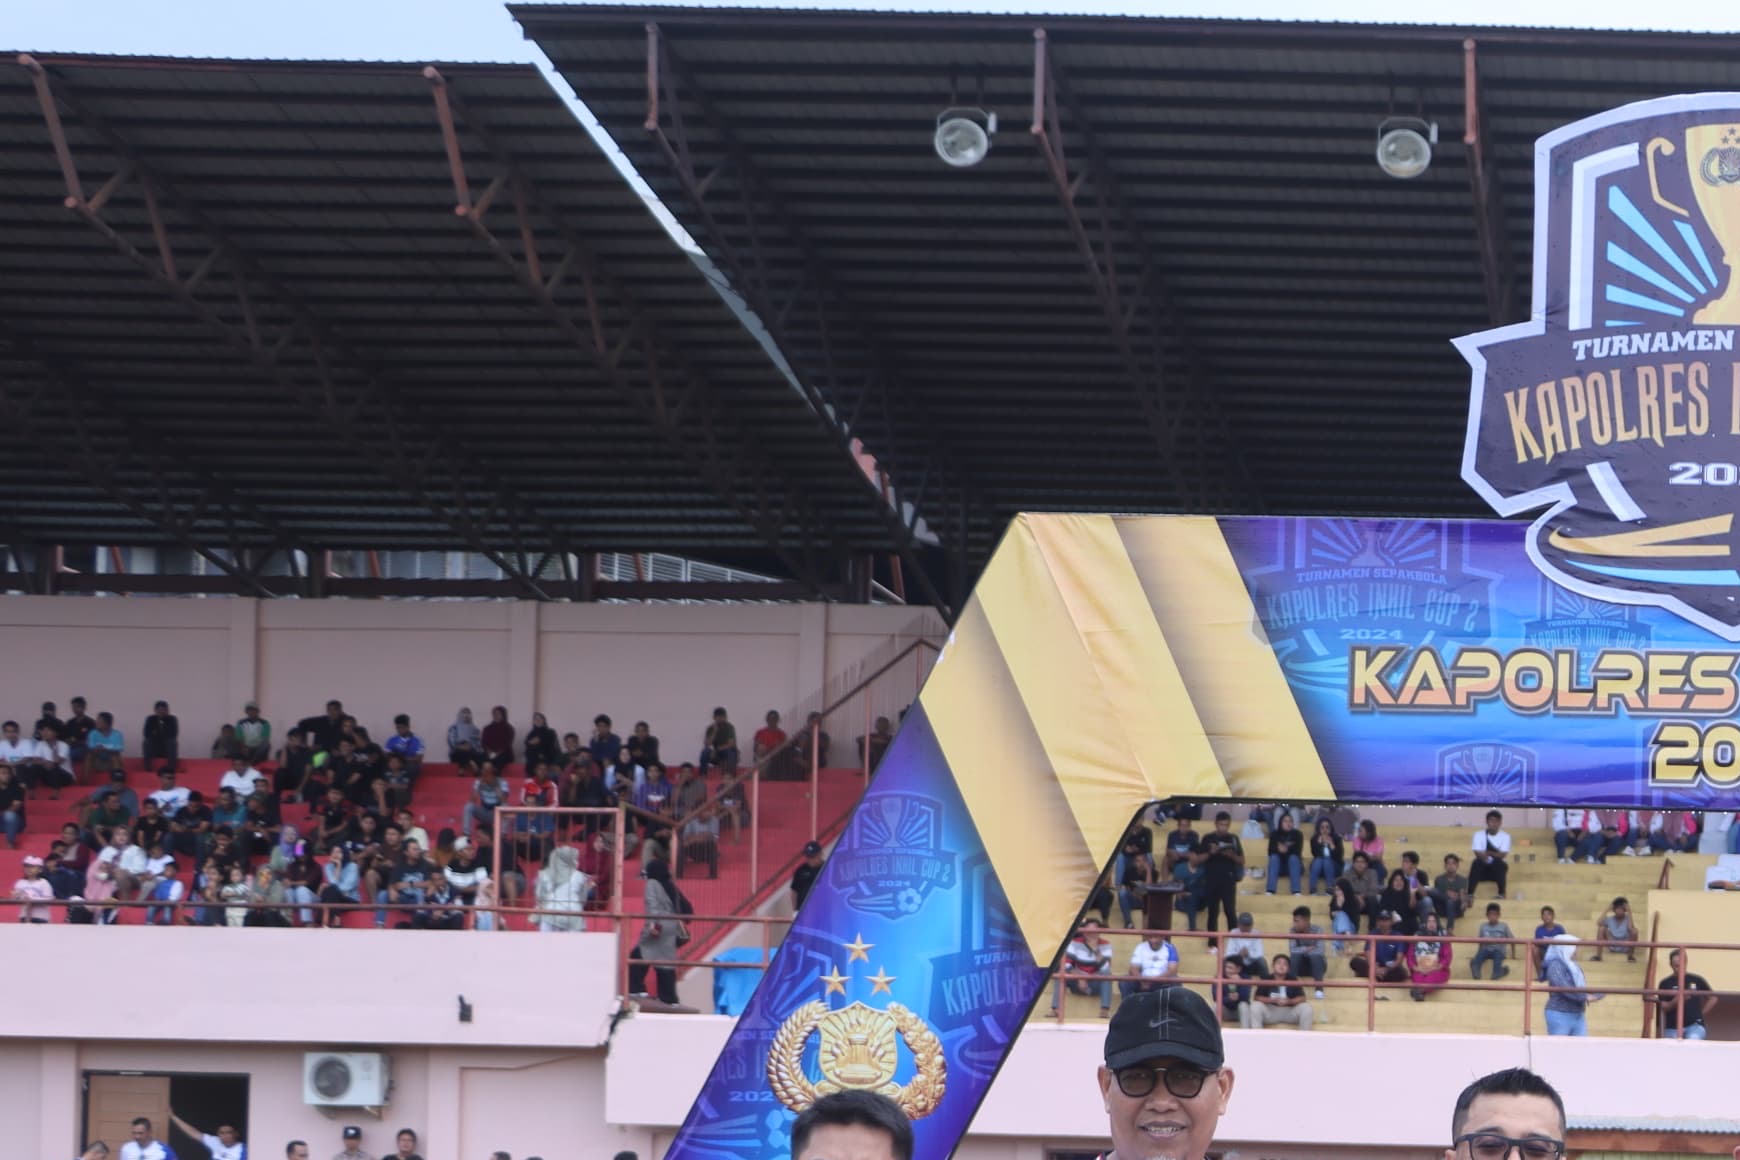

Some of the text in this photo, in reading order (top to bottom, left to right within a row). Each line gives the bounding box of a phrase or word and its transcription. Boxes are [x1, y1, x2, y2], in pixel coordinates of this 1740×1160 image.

[1573, 329, 1734, 361] TURNAMEN
[1504, 361, 1709, 466] KAPOLRES
[728, 1090, 776, 1103] 202
